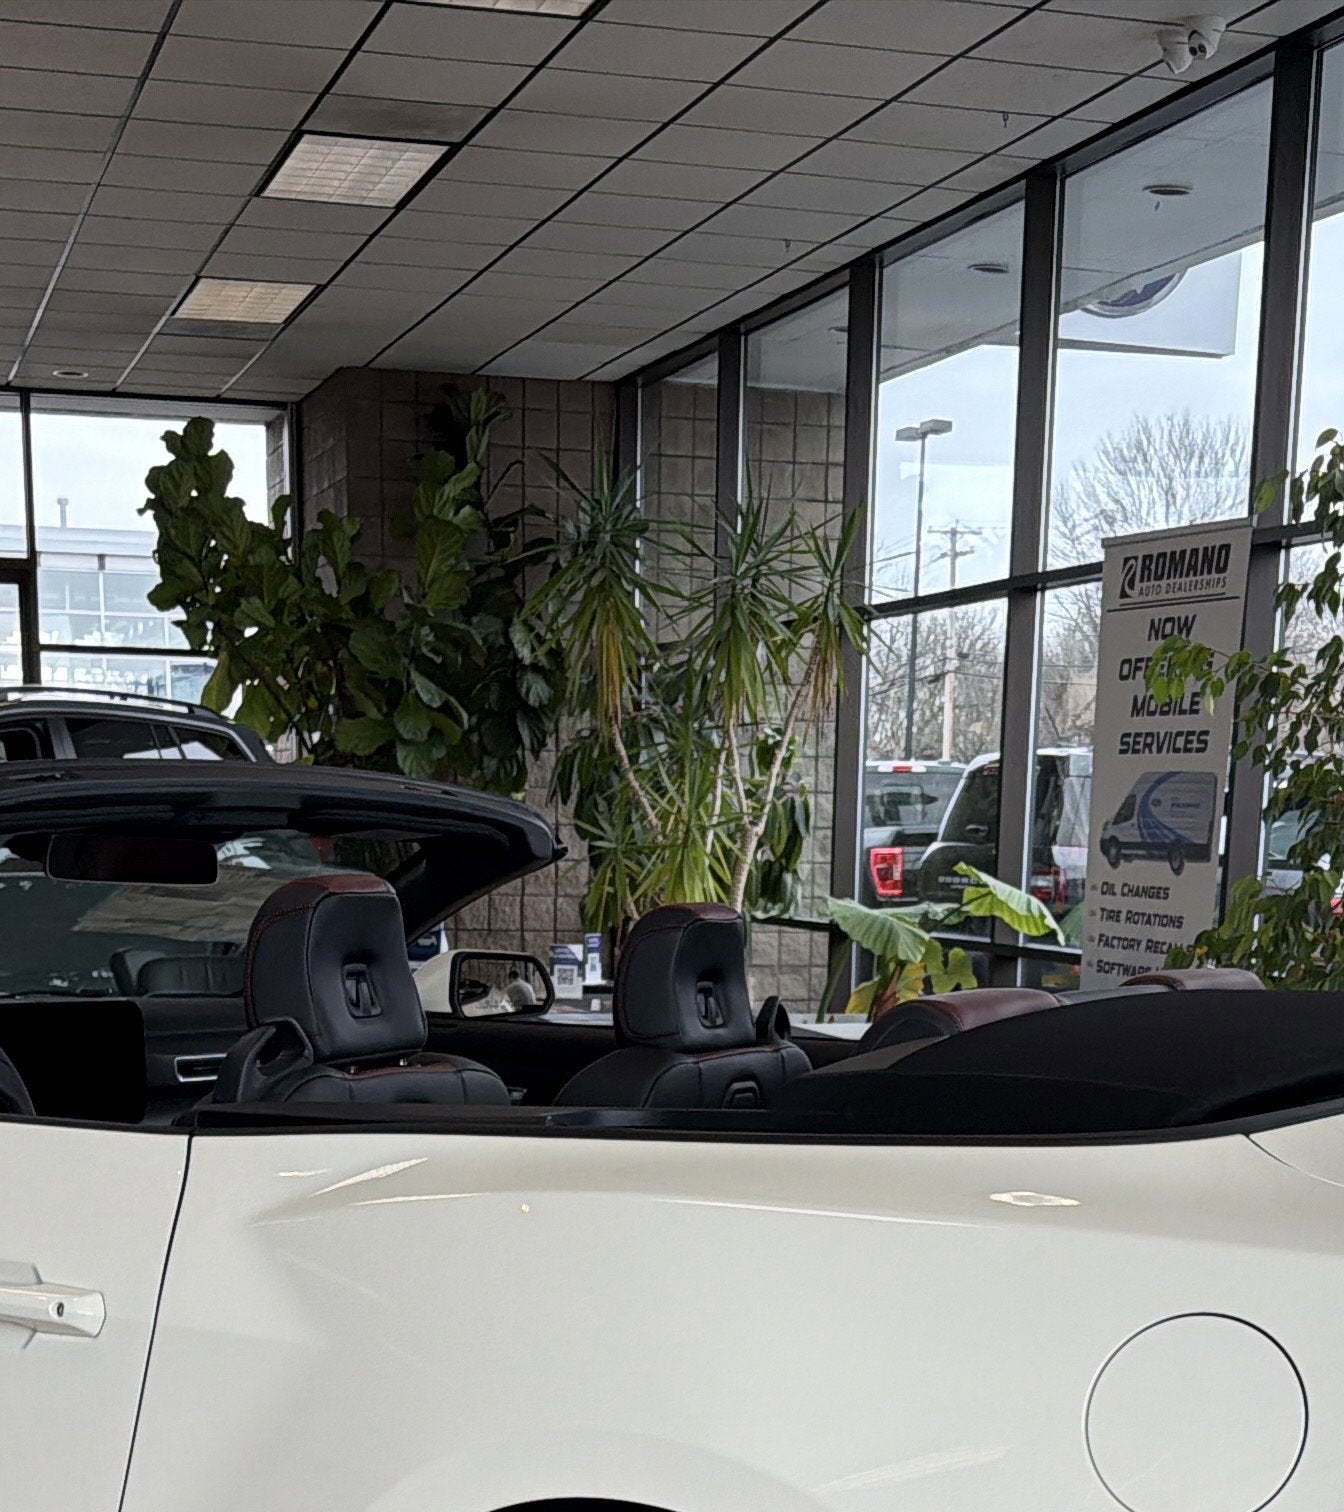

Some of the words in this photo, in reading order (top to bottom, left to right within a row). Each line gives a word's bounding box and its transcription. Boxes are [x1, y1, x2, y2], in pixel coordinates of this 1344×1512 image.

[1138, 543, 1232, 583] ROMANO
[1138, 585, 1162, 598] AUTO
[1165, 576, 1227, 594] DEALERSHIPS
[1147, 614, 1197, 642] NOW
[1130, 692, 1201, 718] MOBILE
[1118, 730, 1210, 755] SERVICES
